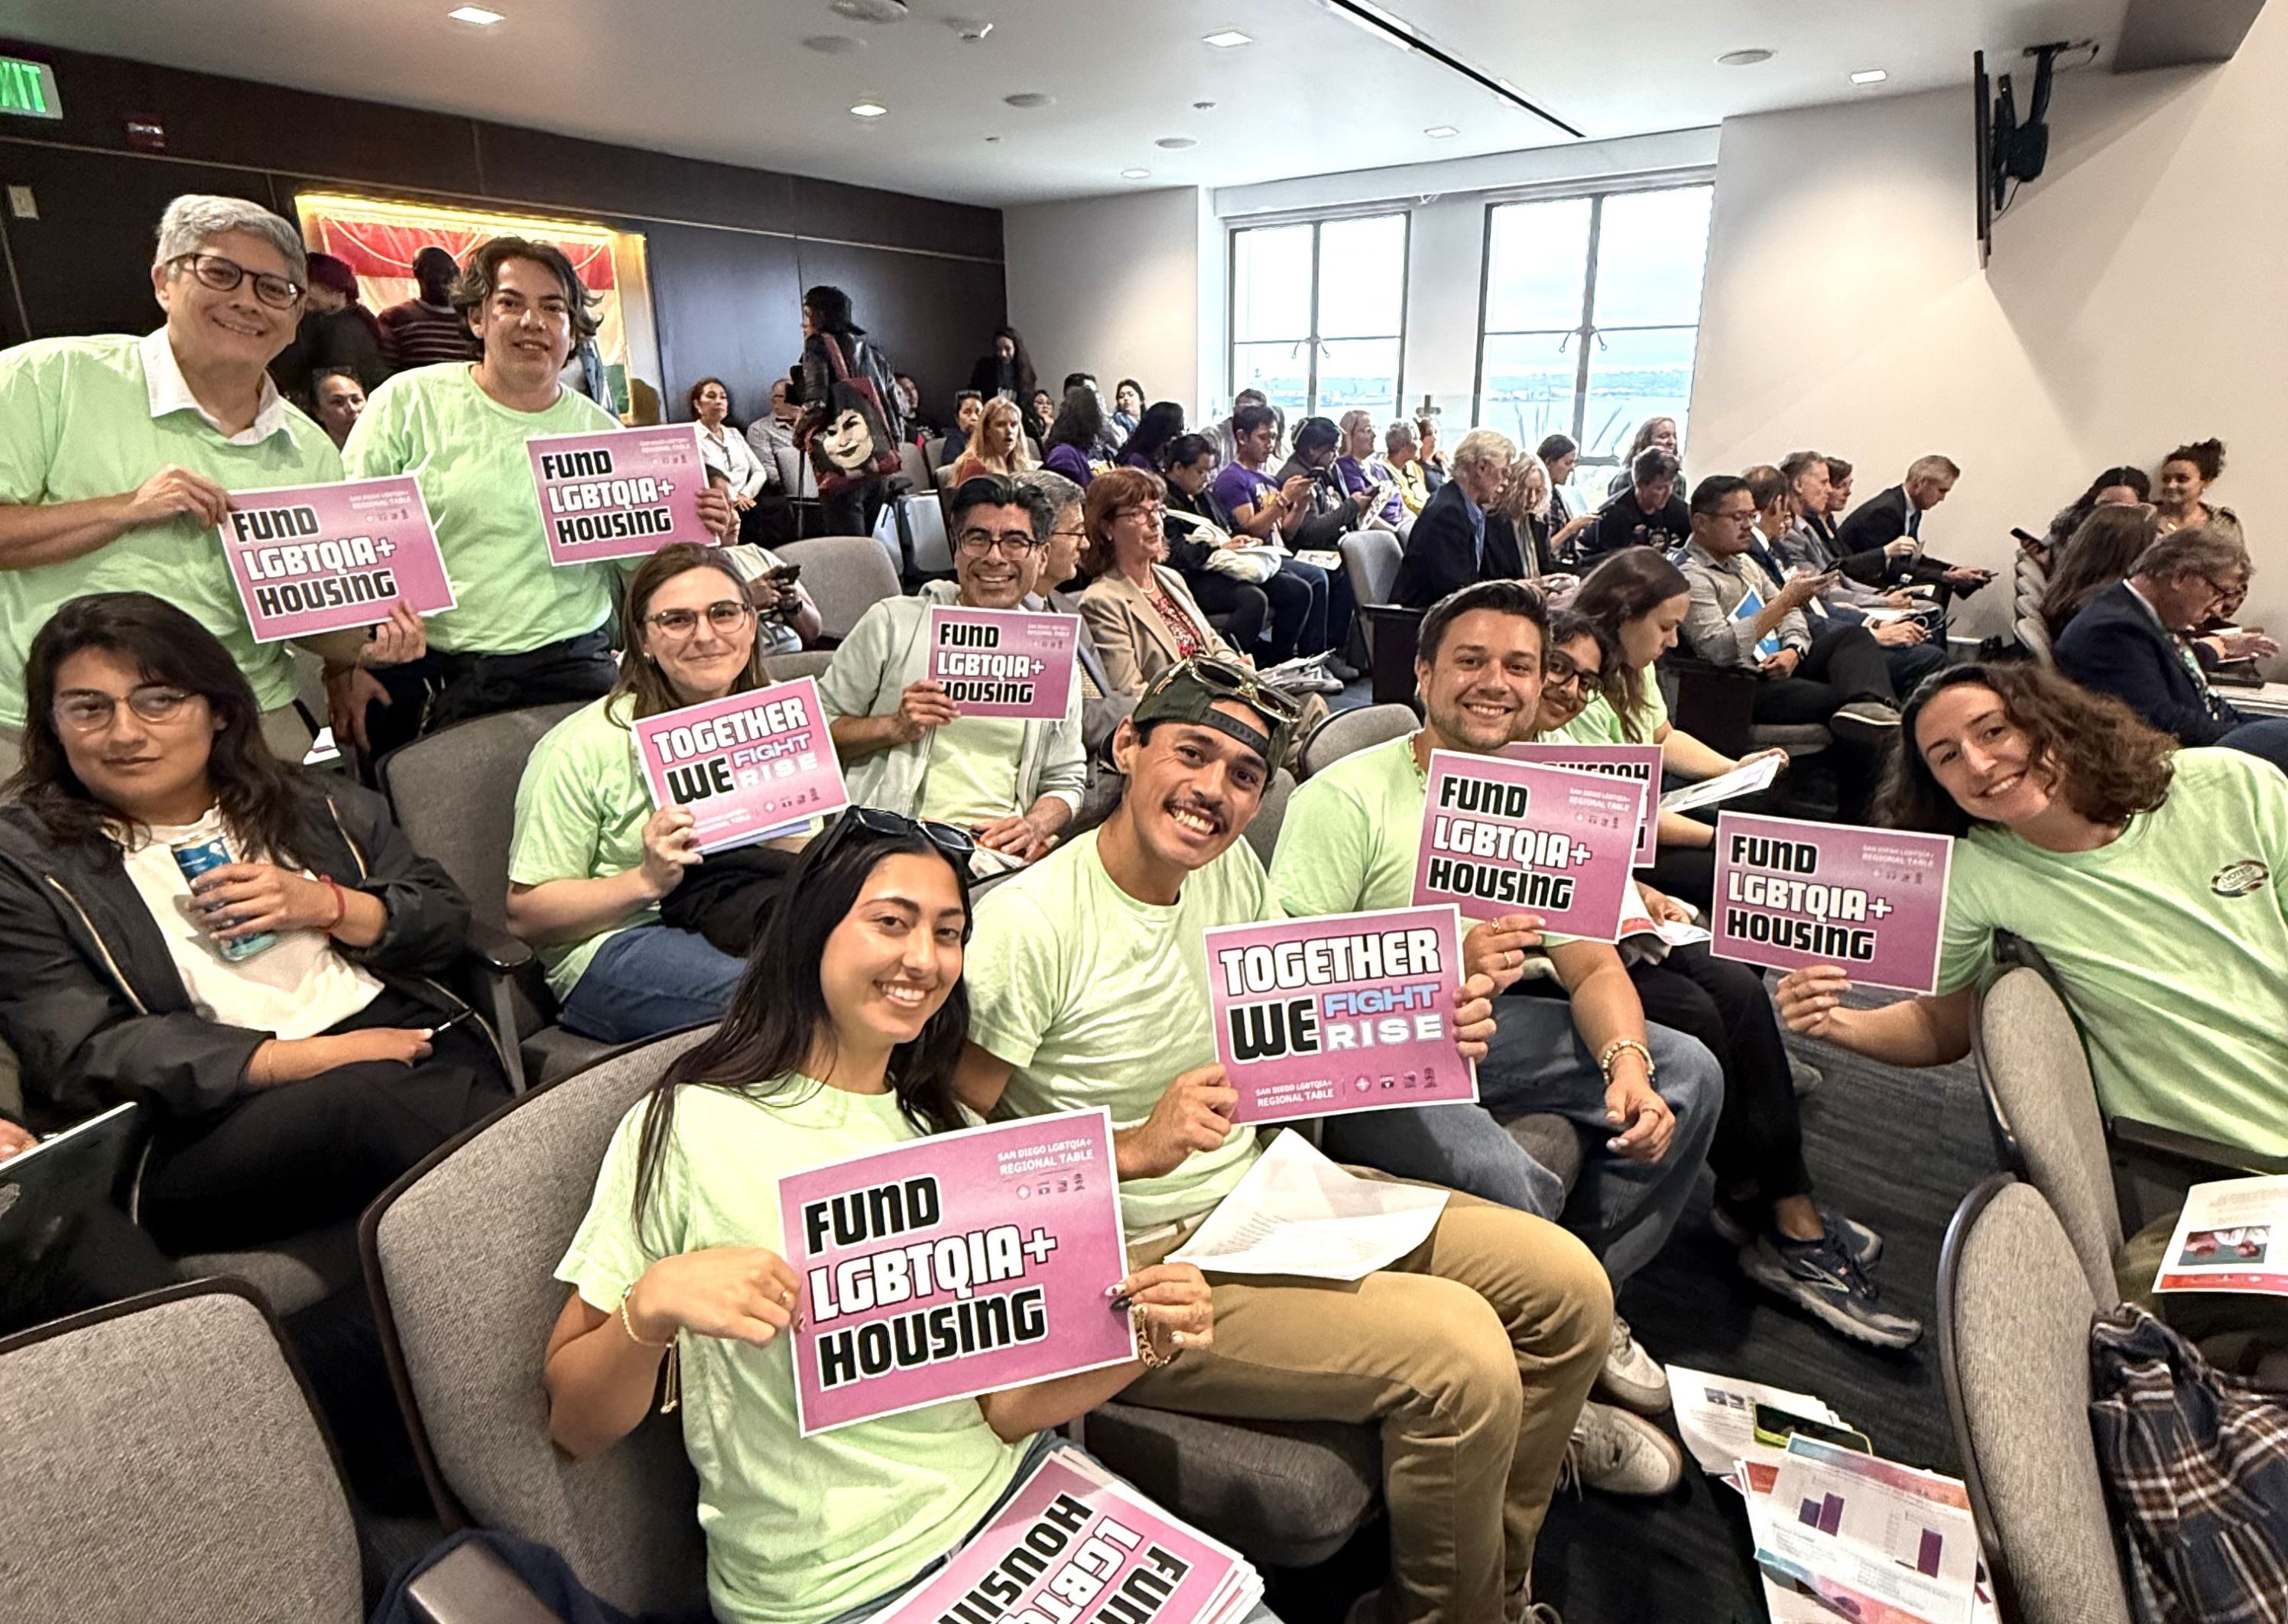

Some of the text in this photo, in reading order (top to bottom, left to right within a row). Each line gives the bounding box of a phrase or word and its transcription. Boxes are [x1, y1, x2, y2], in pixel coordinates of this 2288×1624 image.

[541, 450, 612, 480] FUND
[547, 477, 675, 514] LGBTQIA+
[231, 507, 320, 542] FUND
[556, 507, 671, 544] HOUSING
[241, 536, 396, 581] LGBTQIA+
[255, 570, 397, 618] HOUSING
[940, 624, 999, 647] FUND
[936, 651, 1046, 681] LGBTQIA+
[651, 696, 810, 764] TOGETHER
[732, 731, 812, 769] FIGHT
[667, 757, 734, 805] WE
[738, 752, 818, 789] RISE
[1439, 776, 1527, 818] FUND
[1433, 815, 1593, 870] LGBTQIA+
[1731, 835, 1817, 874] FUND
[1428, 857, 1573, 909] HOUSING
[1728, 870, 1894, 922] LGBTQIA+
[1728, 909, 1874, 960] HOUSING
[1219, 927, 1443, 997] TOGETHER
[1322, 981, 1442, 1019] FIGHT
[1229, 998, 1319, 1060] WE
[1326, 1013, 1444, 1051] RISE
[1255, 1088, 1271, 1097] SAN
[1272, 1084, 1295, 1094] DIEGO
[1257, 1088, 1334, 1107] REGIONAL TABLE
[997, 1138, 1093, 1162] SAN DIEGO LGBTQIA+
[999, 1149, 1095, 1175] REGIONAL TABLE
[805, 1176, 940, 1254] FUND
[809, 1224, 1058, 1324] LGBTQIA+
[819, 1289, 1046, 1387] HOUSING
[1089, 1547, 1189, 1624] FUN
